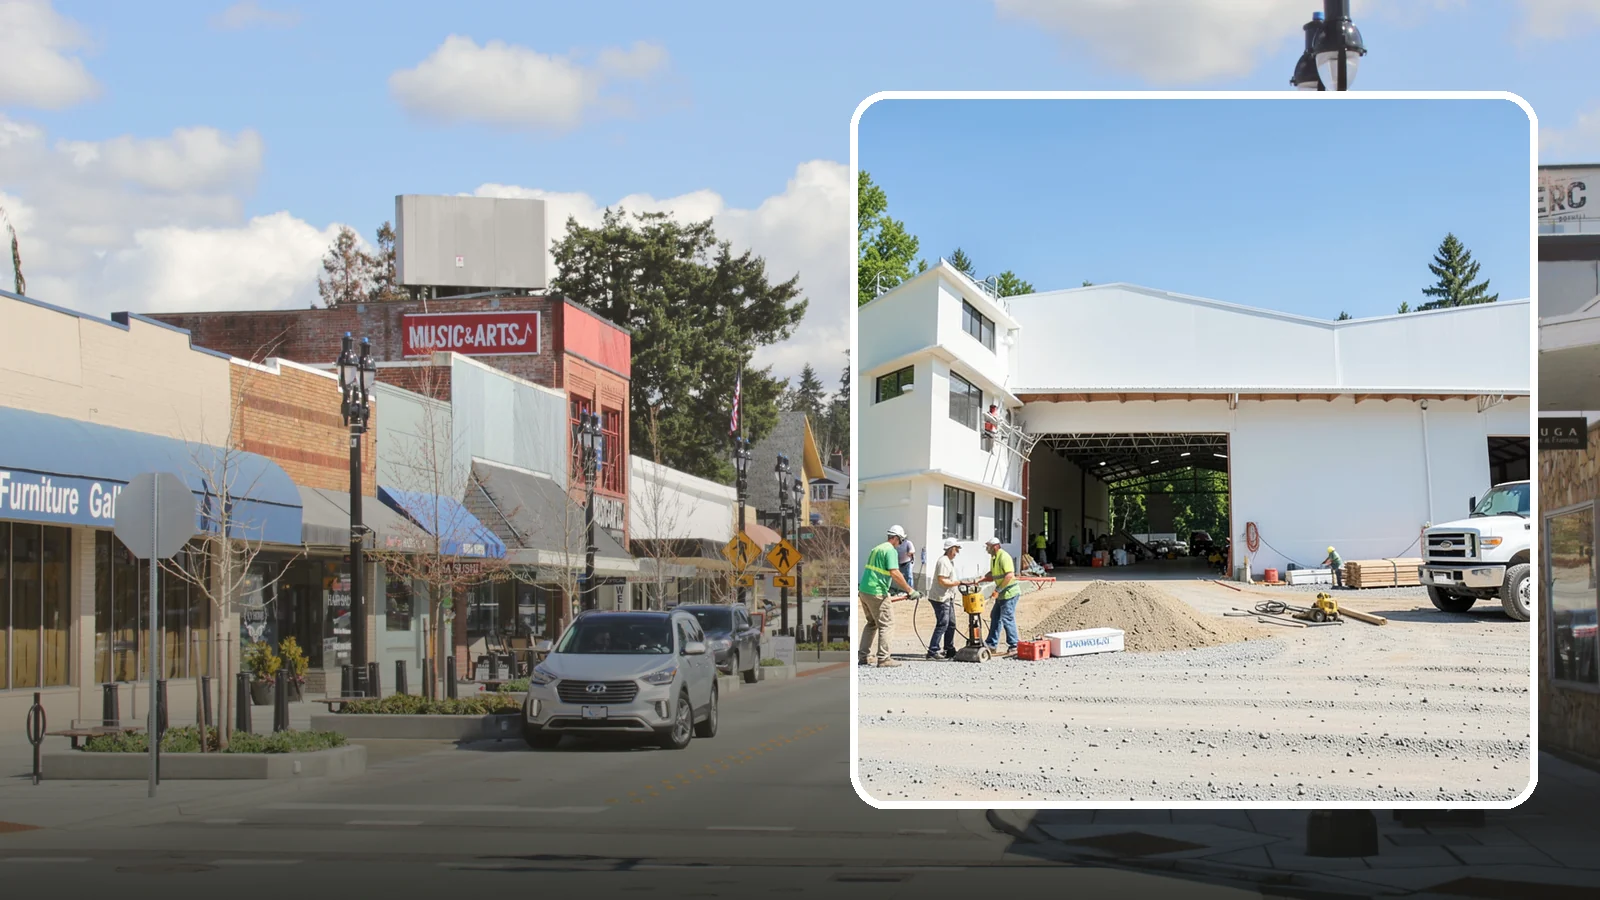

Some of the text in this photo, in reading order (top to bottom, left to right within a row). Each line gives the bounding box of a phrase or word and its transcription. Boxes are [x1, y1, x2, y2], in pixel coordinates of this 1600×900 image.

[1540, 427, 1577, 437] UGA
[0, 471, 121, 519] Furniture Gal
